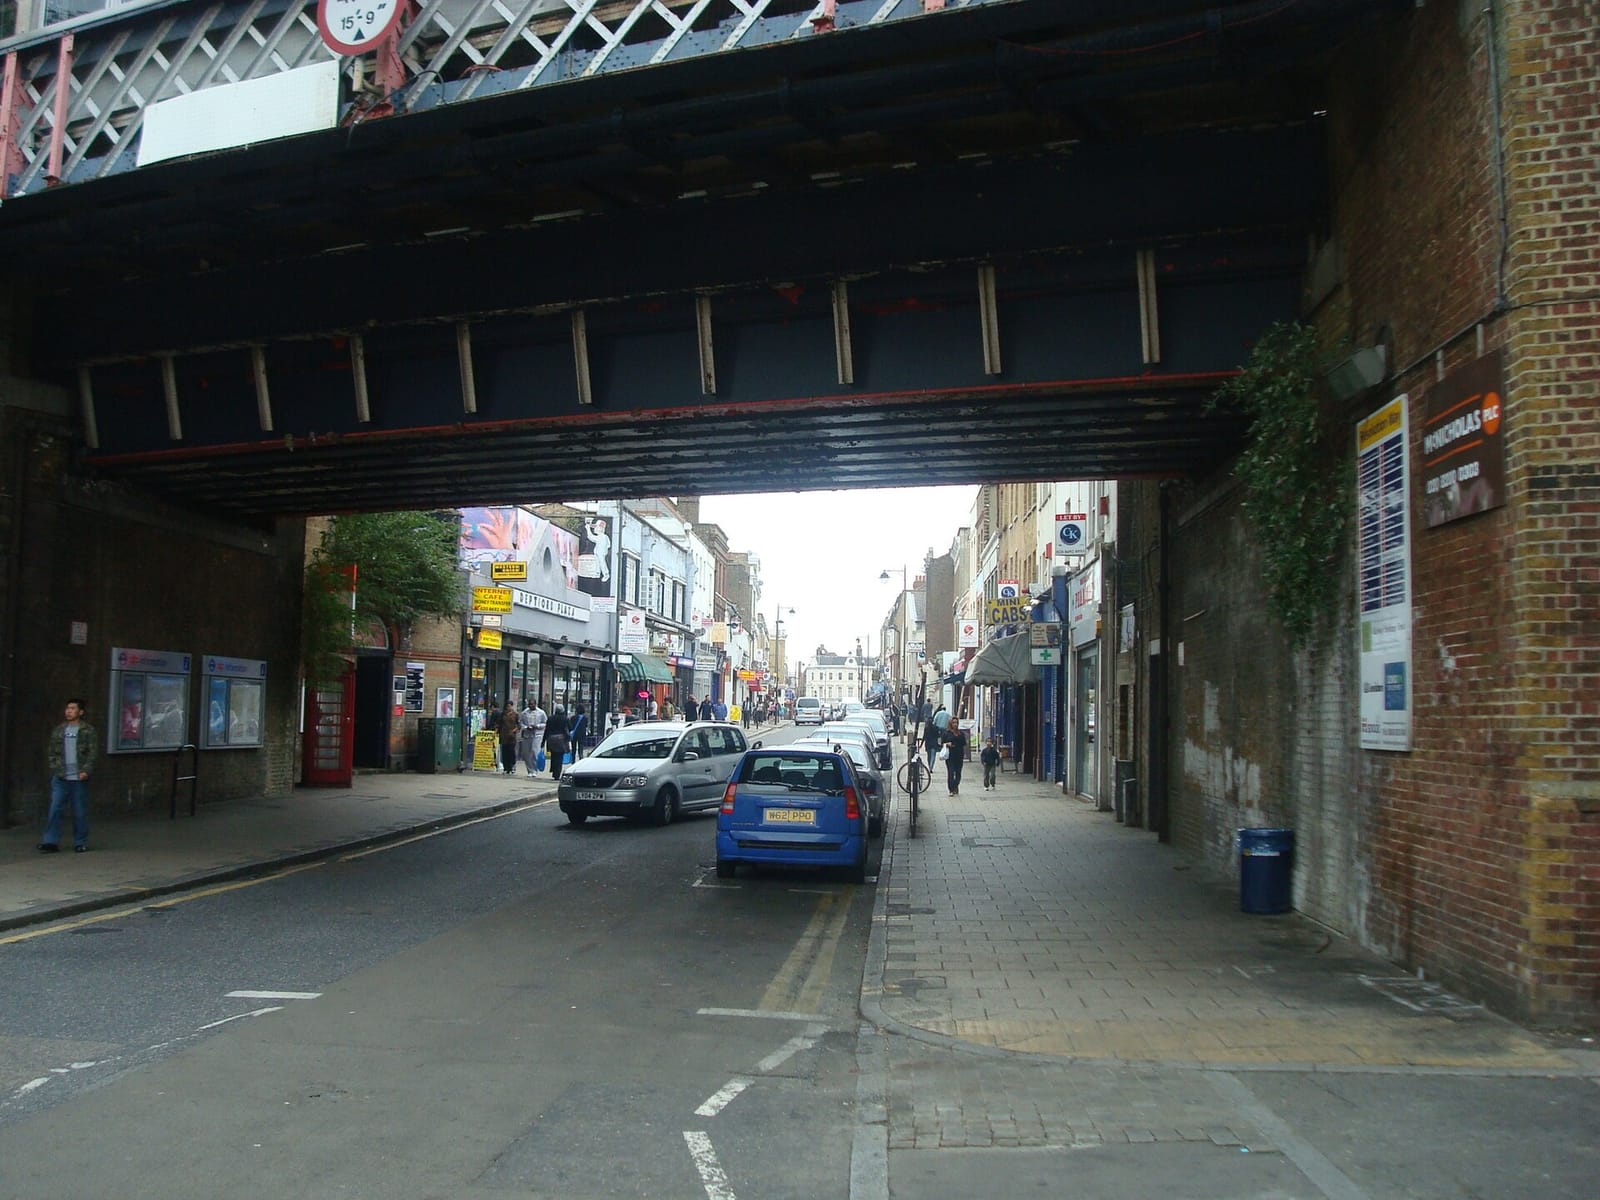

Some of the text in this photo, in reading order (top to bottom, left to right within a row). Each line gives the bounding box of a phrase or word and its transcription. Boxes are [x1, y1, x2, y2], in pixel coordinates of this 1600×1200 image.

[1482, 405, 1499, 422] PLC
[1062, 527, 1078, 539] CK
[474, 587, 512, 595] INTERNET
[997, 597, 1020, 606] MINI
[991, 605, 1028, 623] CABS
[792, 811, 812, 820] PPO
